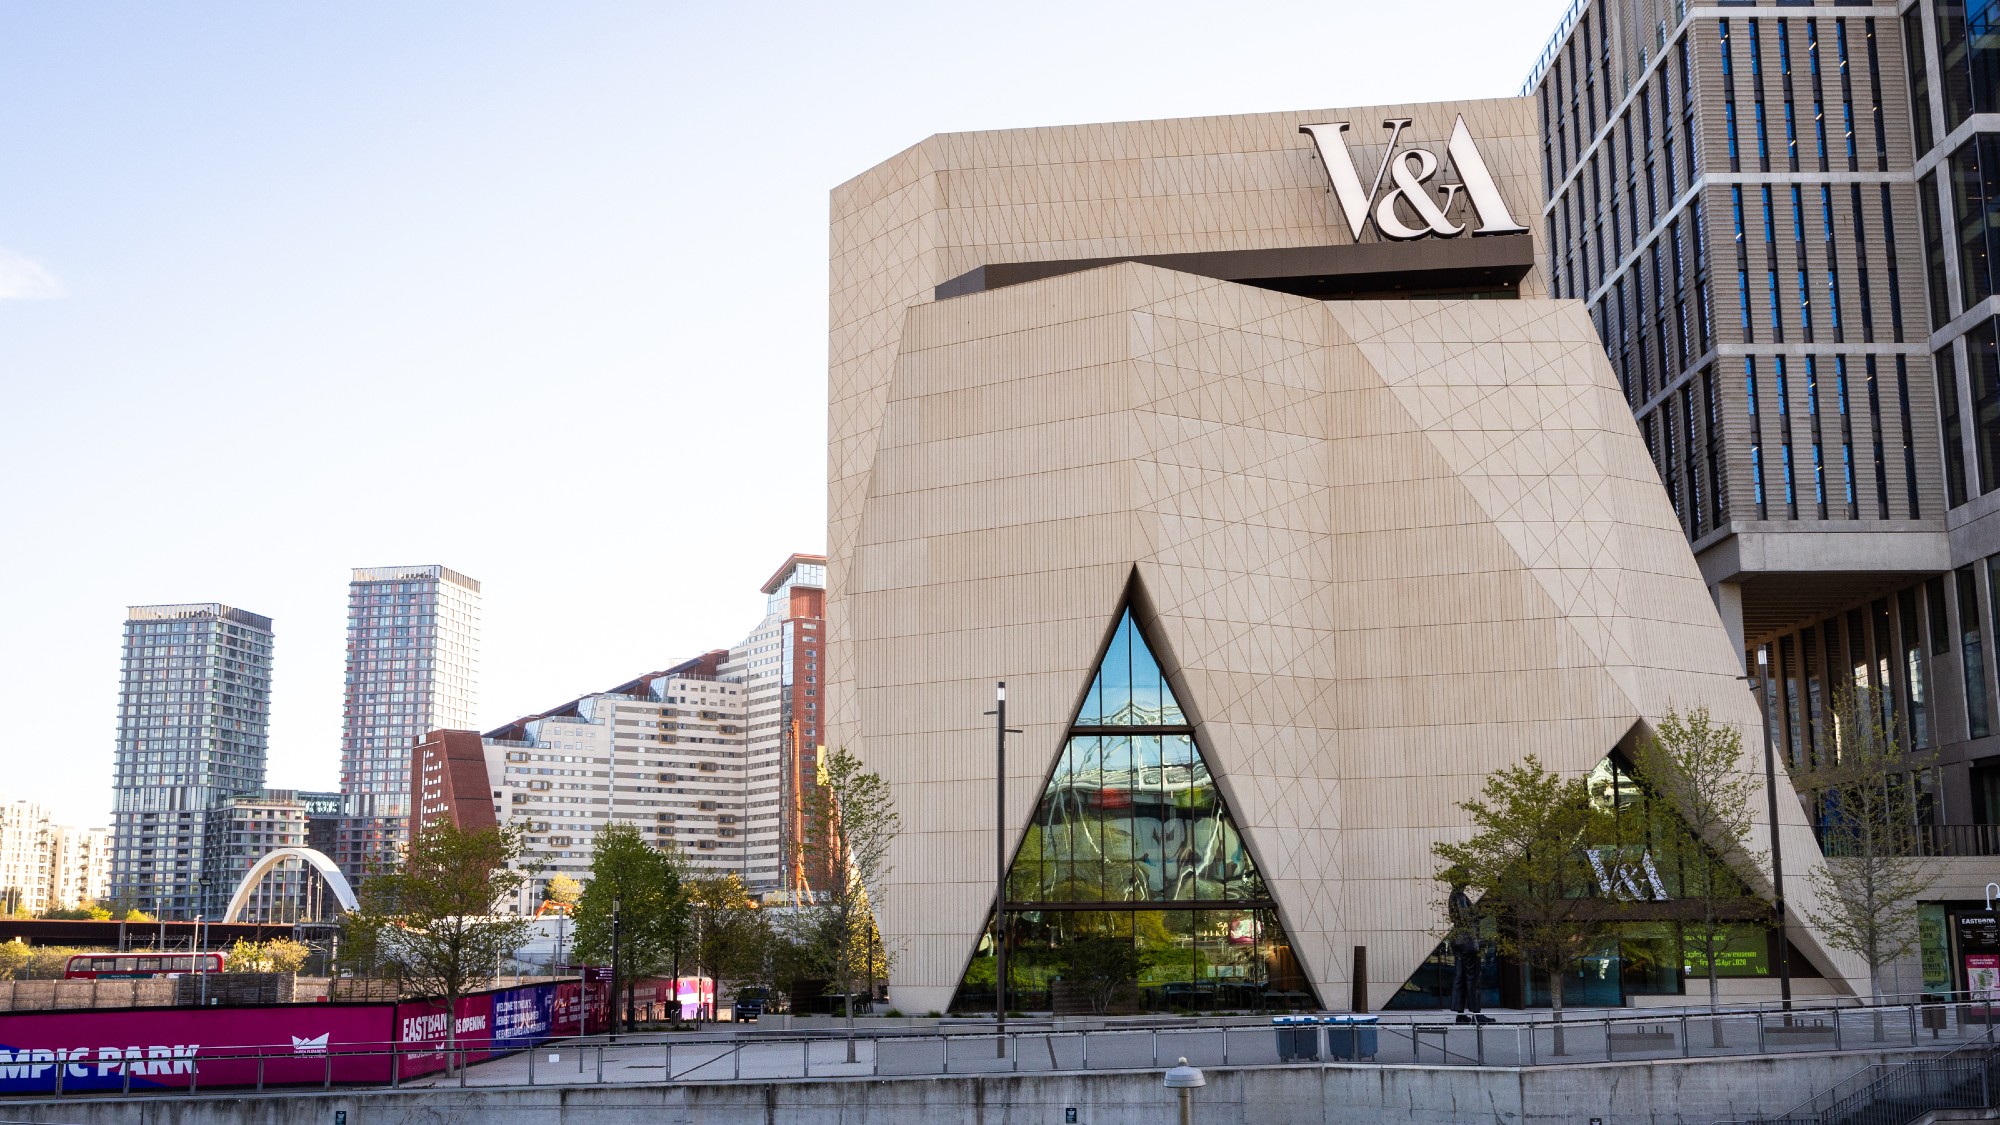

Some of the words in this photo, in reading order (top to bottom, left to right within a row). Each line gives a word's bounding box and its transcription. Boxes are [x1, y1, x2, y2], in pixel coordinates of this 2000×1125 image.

[1299, 113, 1530, 242] V&A
[1582, 849, 1675, 901] V&A
[403, 1013, 446, 1042] EASTBAN
[462, 1015, 486, 1033] OPENING
[98, 1045, 200, 1077] PARK
